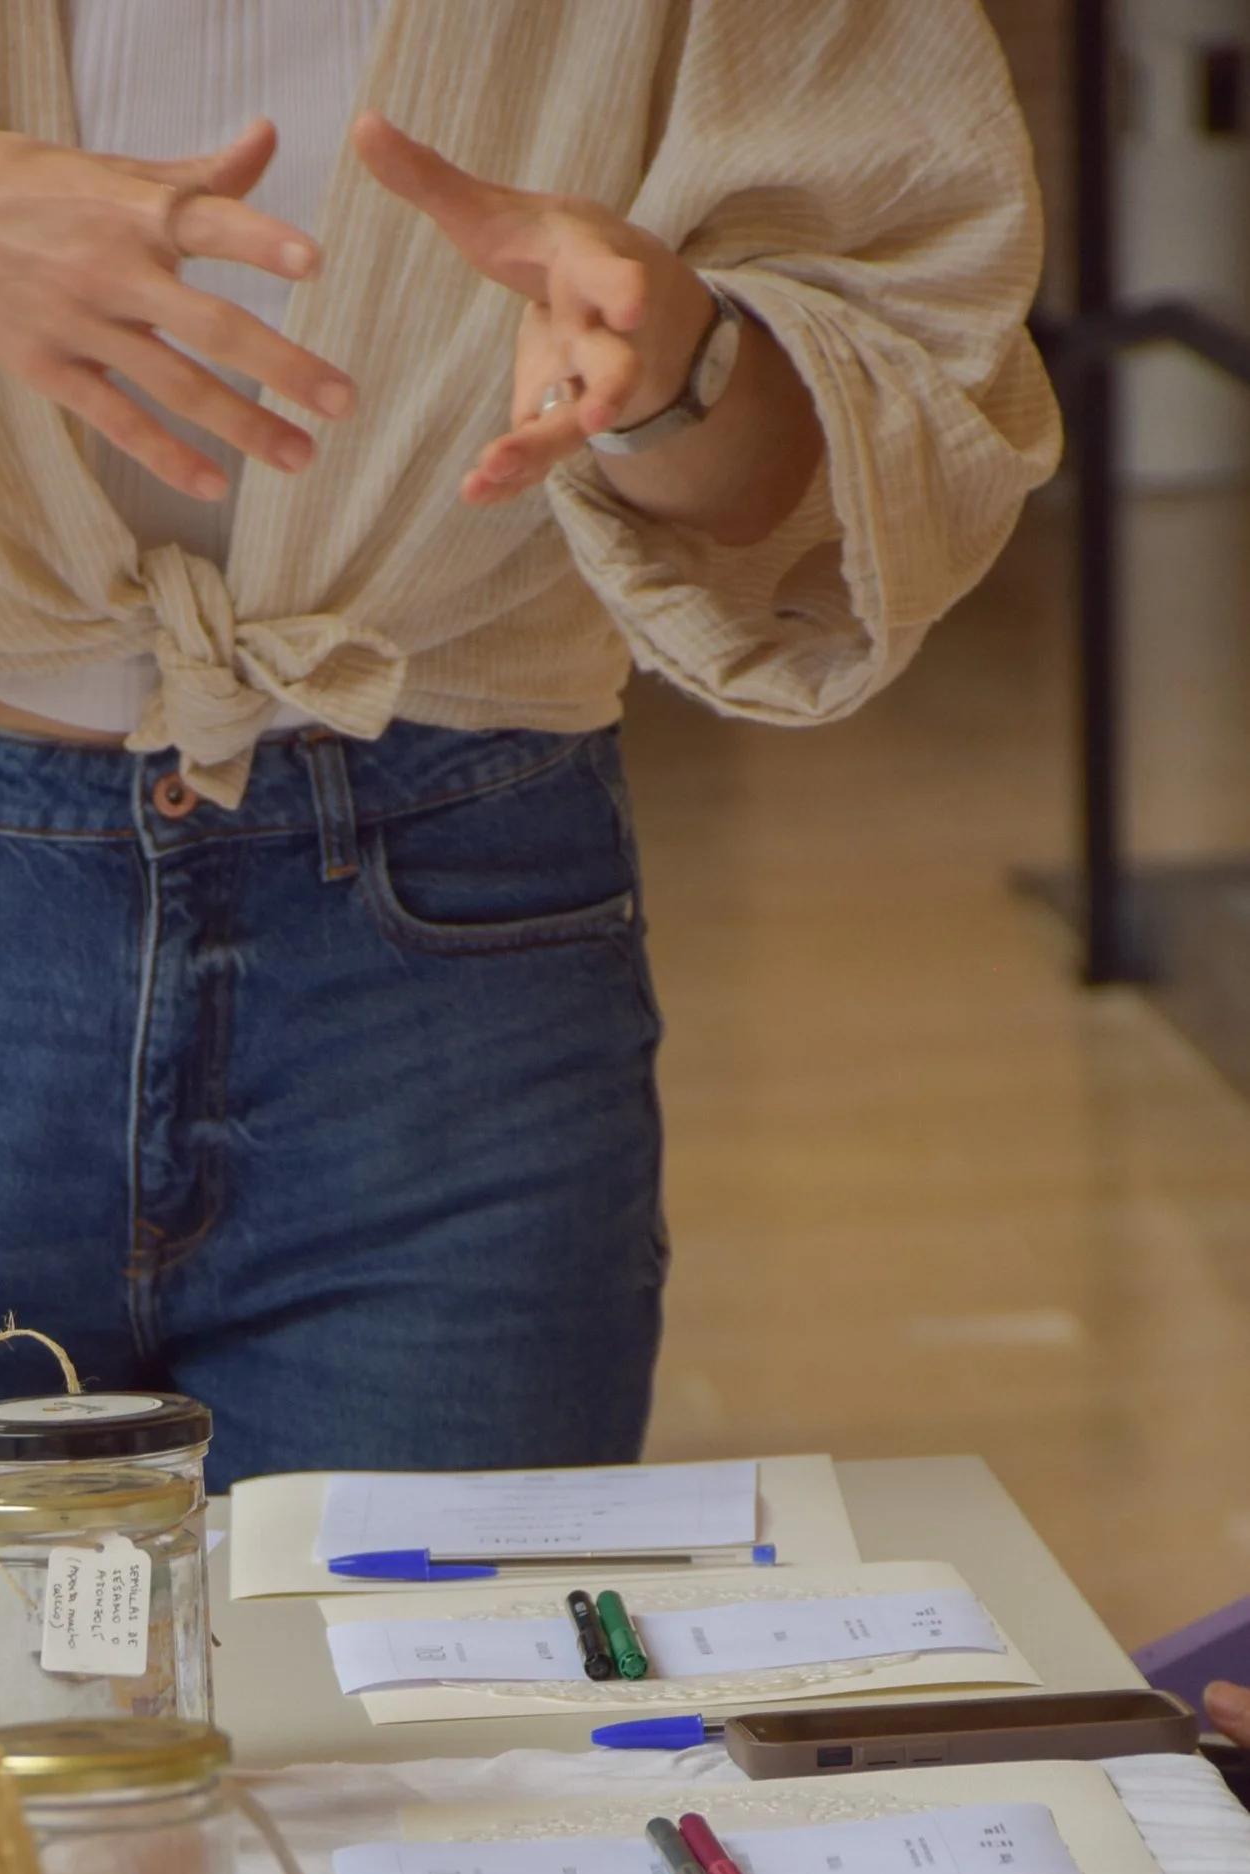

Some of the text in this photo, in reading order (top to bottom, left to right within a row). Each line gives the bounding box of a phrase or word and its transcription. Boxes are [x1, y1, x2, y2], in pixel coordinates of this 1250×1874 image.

[111, 1569, 126, 1645] SÉSAMO O
[66, 1608, 80, 1650] mucho
[127, 1631, 138, 1648] DE
